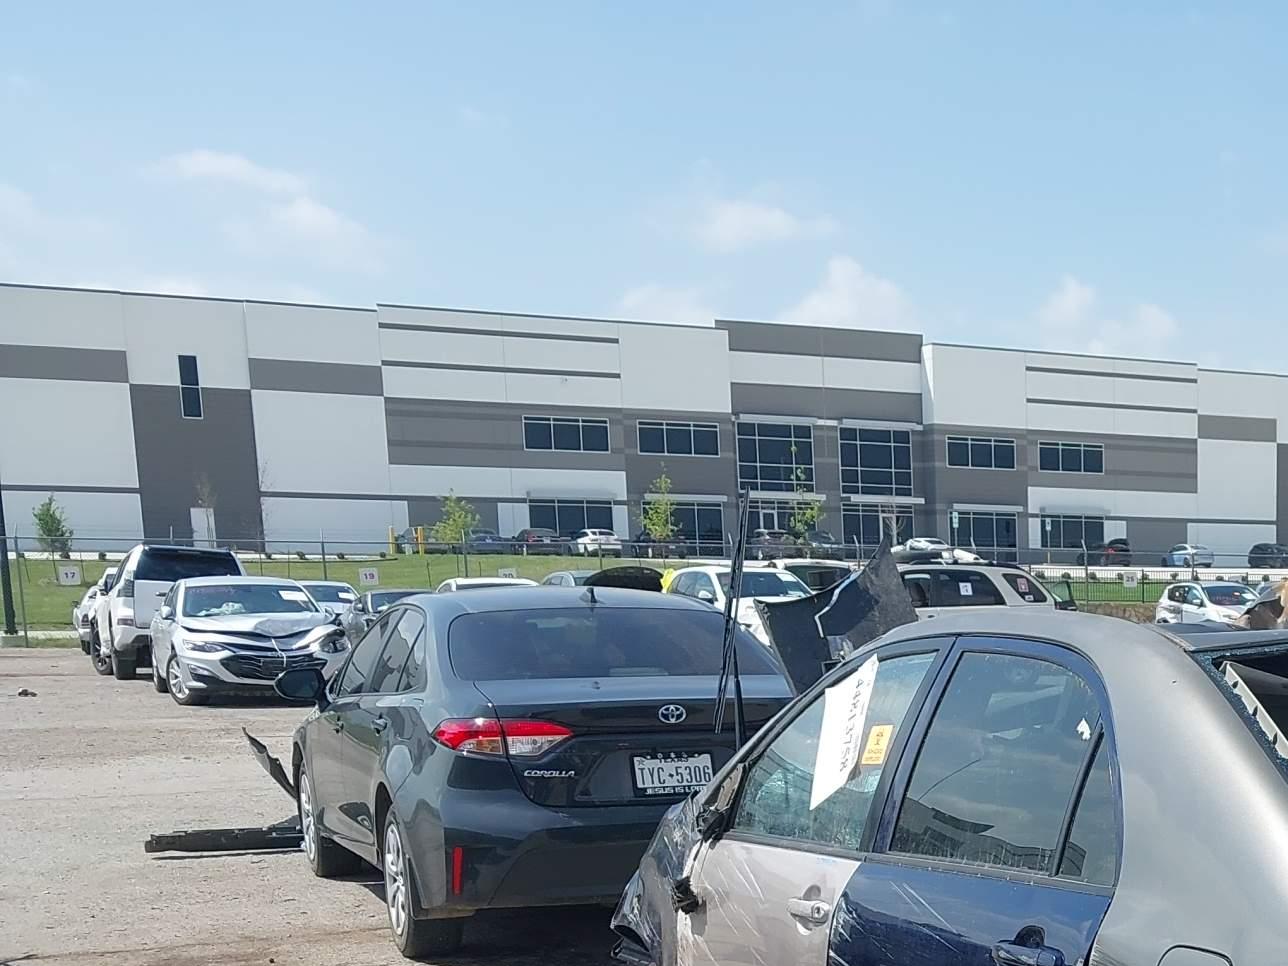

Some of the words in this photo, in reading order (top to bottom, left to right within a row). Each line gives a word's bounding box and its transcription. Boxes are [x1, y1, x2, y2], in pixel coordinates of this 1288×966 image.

[64, 571, 76, 579] 17
[363, 572, 375, 580] 19
[523, 769, 576, 778] COROLLA
[644, 787, 674, 795] JESUS
